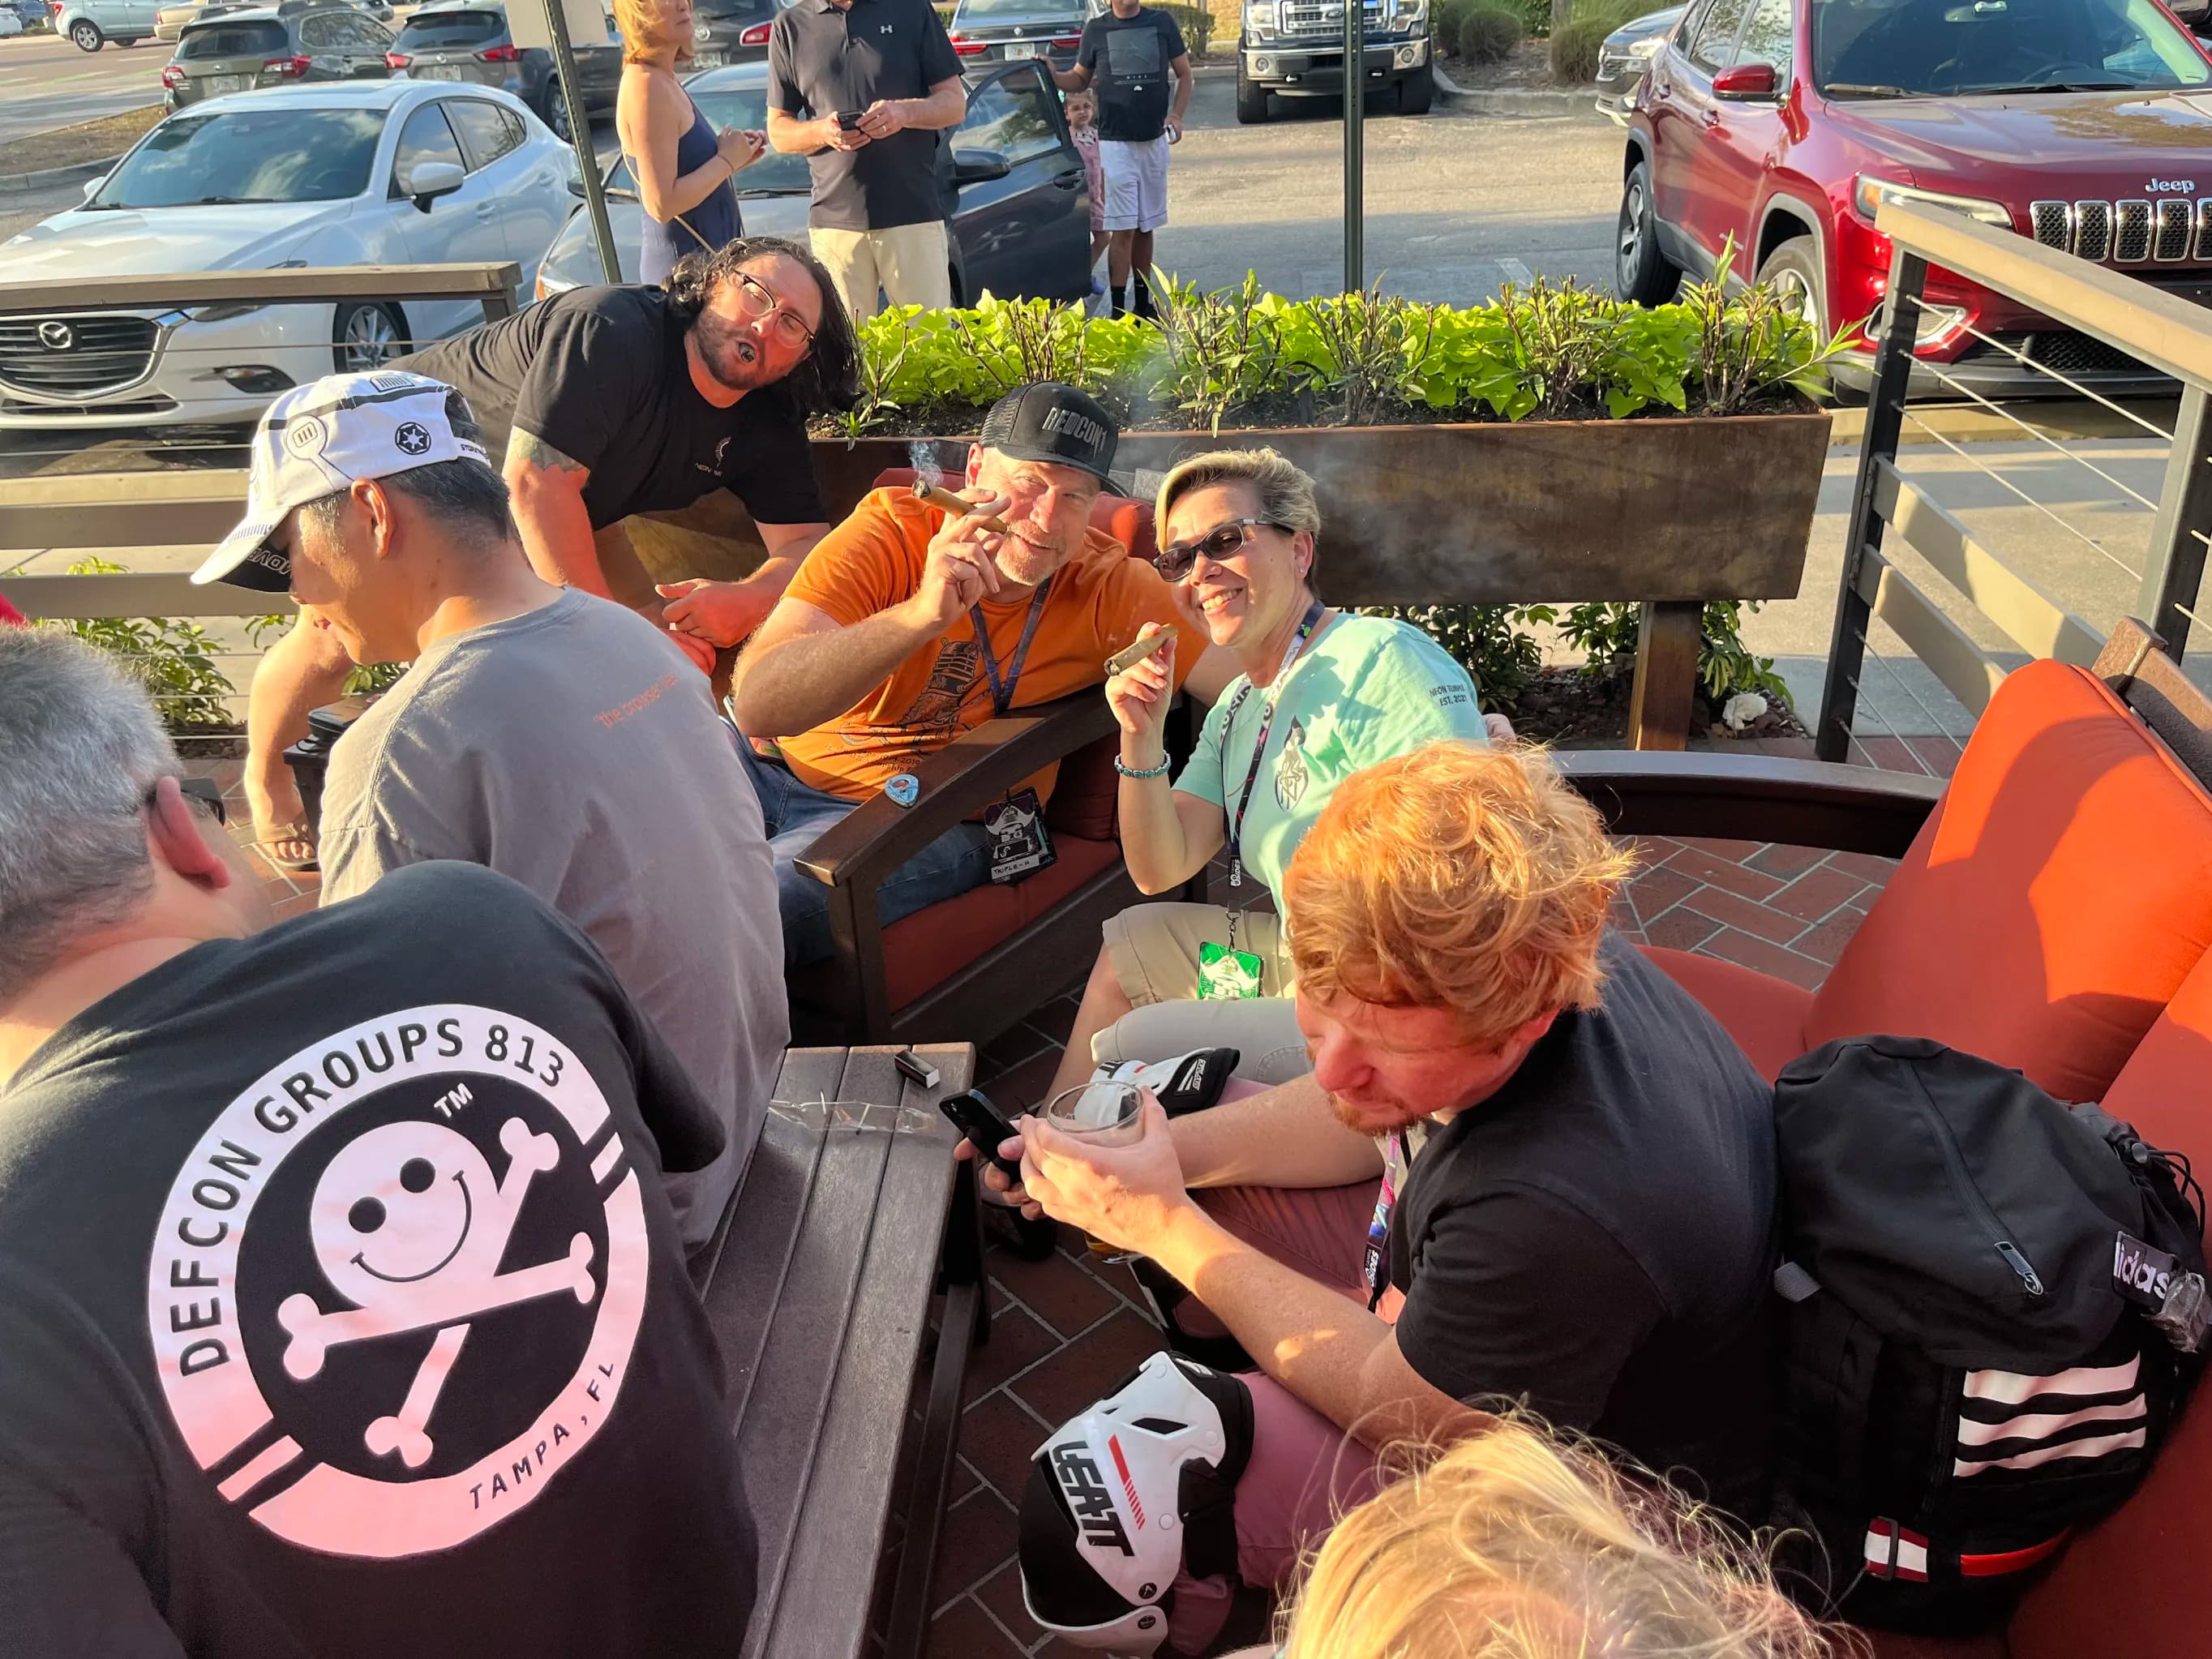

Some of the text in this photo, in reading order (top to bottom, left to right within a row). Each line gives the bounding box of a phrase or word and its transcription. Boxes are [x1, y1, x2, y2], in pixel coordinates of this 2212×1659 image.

[2145, 178, 2195, 194] Jeep
[1041, 406, 1108, 460] REDCON1
[1429, 684, 1447, 697] NEON
[1439, 696, 1454, 706] EST.
[434, 1082, 474, 1118] TM
[170, 1018, 565, 1377] DEFCON GROUPS 813
[585, 1359, 615, 1403] FL
[1052, 1440, 1135, 1557] LEATT
